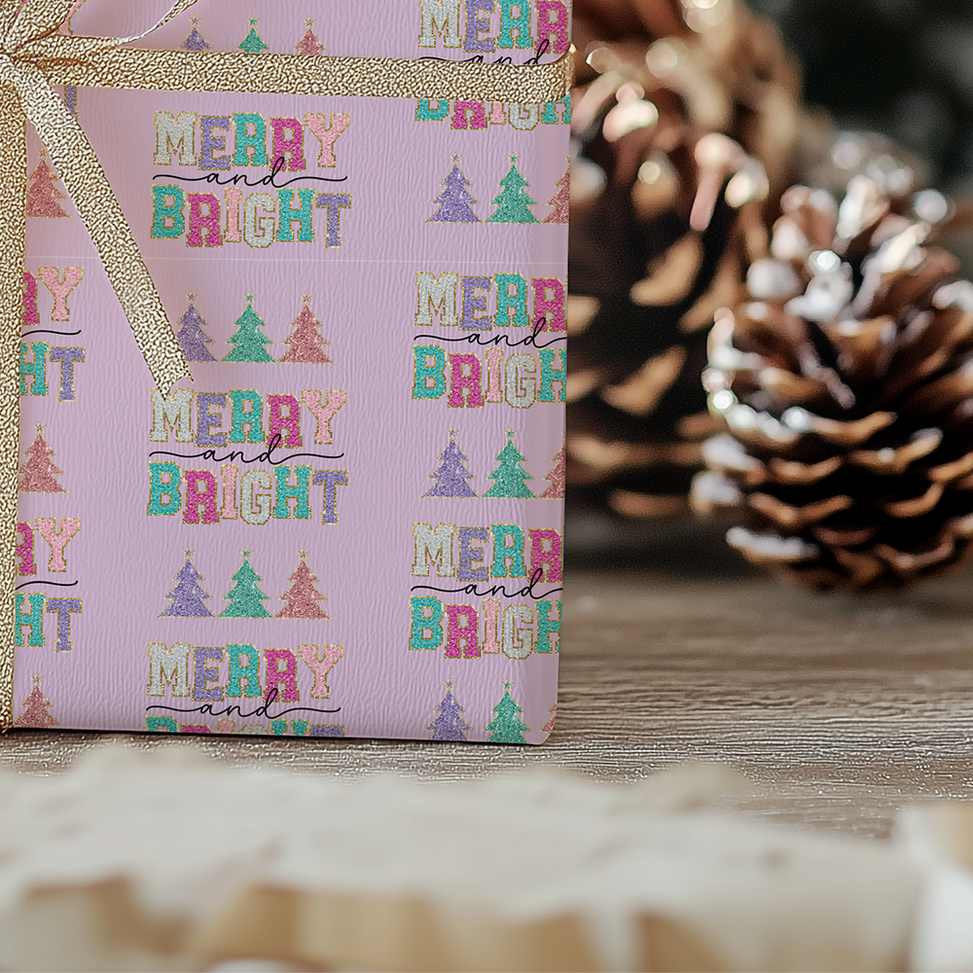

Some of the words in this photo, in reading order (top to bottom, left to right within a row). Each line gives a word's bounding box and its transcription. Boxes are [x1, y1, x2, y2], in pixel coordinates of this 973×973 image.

[153, 111, 350, 172] MERRY
[150, 185, 352, 248] BRIGHT
[414, 272, 567, 332] MERR
[411, 345, 567, 408] BRIGH
[149, 388, 347, 448] MERRY
[147, 461, 348, 525] BRIGHT
[411, 523, 564, 583] MERR
[408, 596, 562, 660] BRIGH
[146, 643, 344, 703] MERRY
